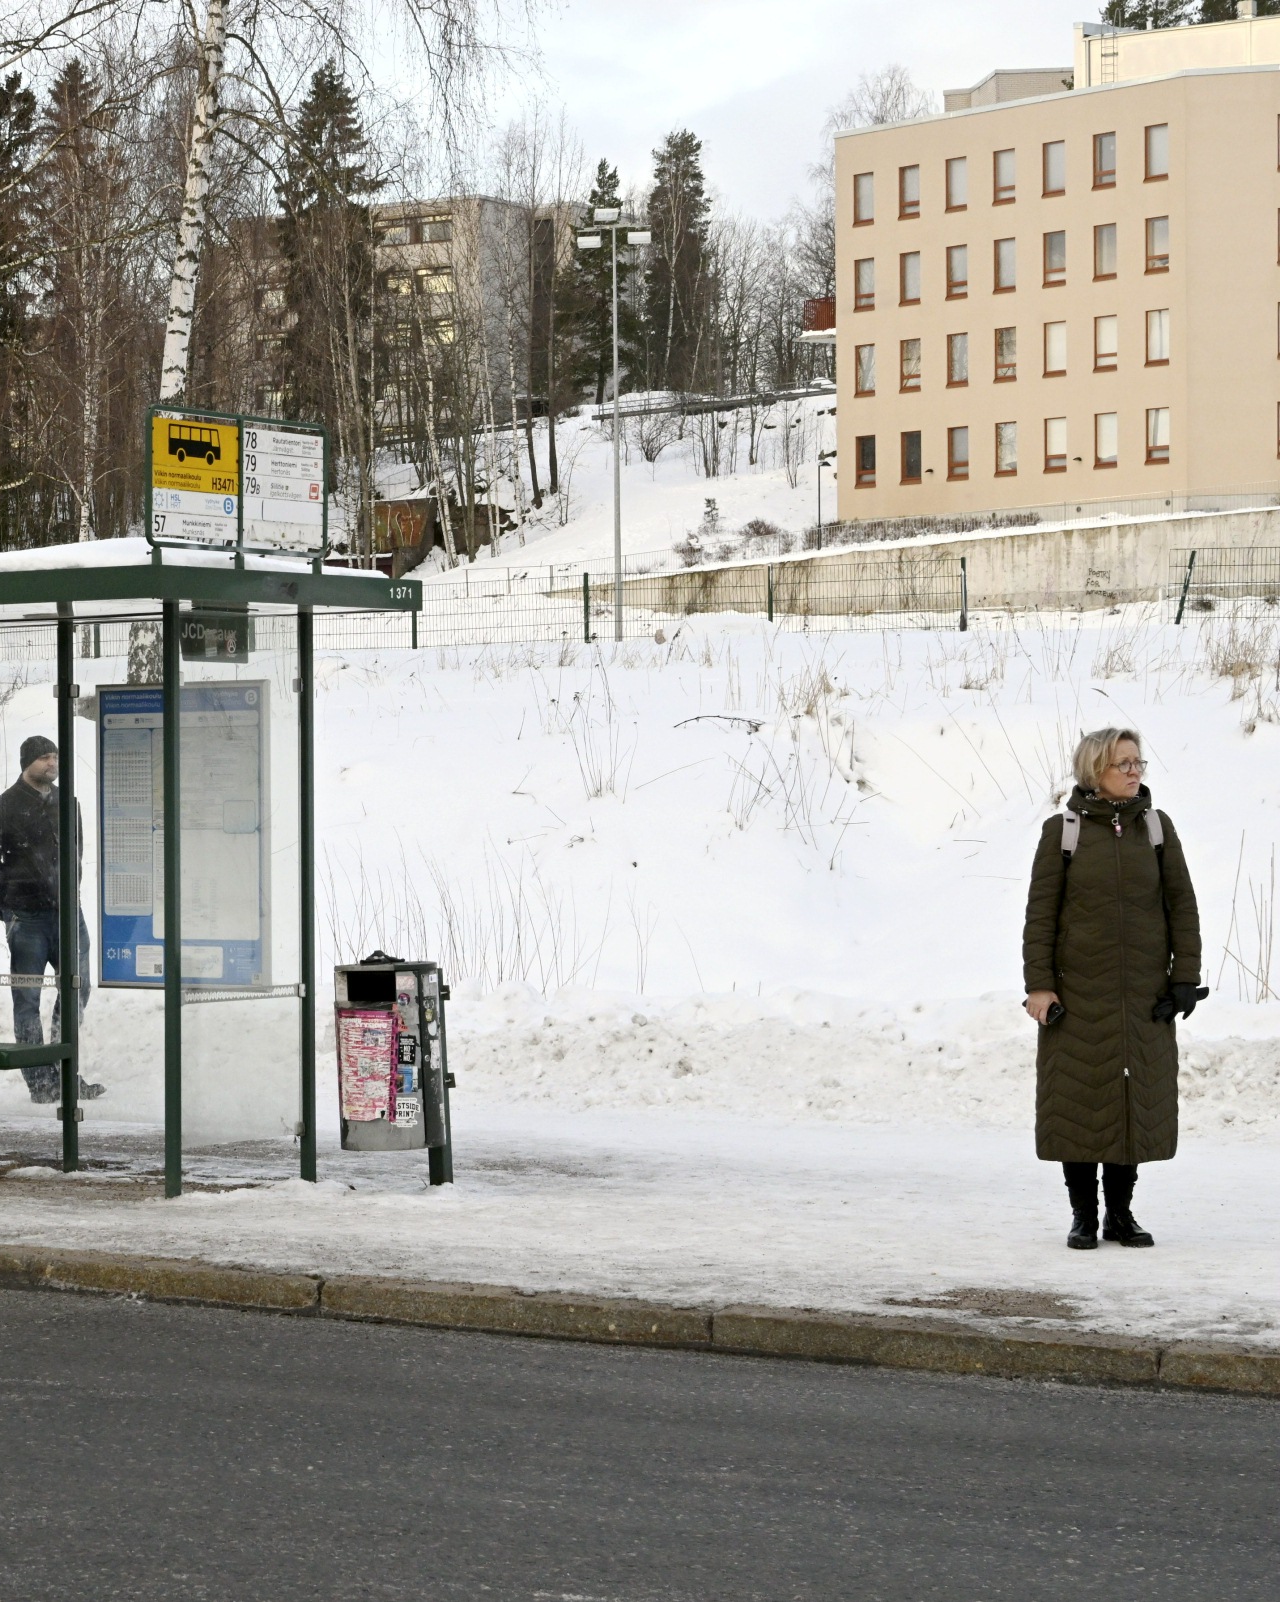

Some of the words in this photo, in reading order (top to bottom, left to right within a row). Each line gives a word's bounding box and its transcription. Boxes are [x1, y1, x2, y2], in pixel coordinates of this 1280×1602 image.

[245, 431, 257, 449] 78
[245, 454, 257, 472] 79
[211, 477, 234, 492] H3471
[170, 493, 181, 502] HSL
[225, 500, 232, 511] B
[154, 514, 166, 532] 57
[182, 519, 211, 528] Munkkiniemi
[396, 1102, 420, 1112] STSIDE
